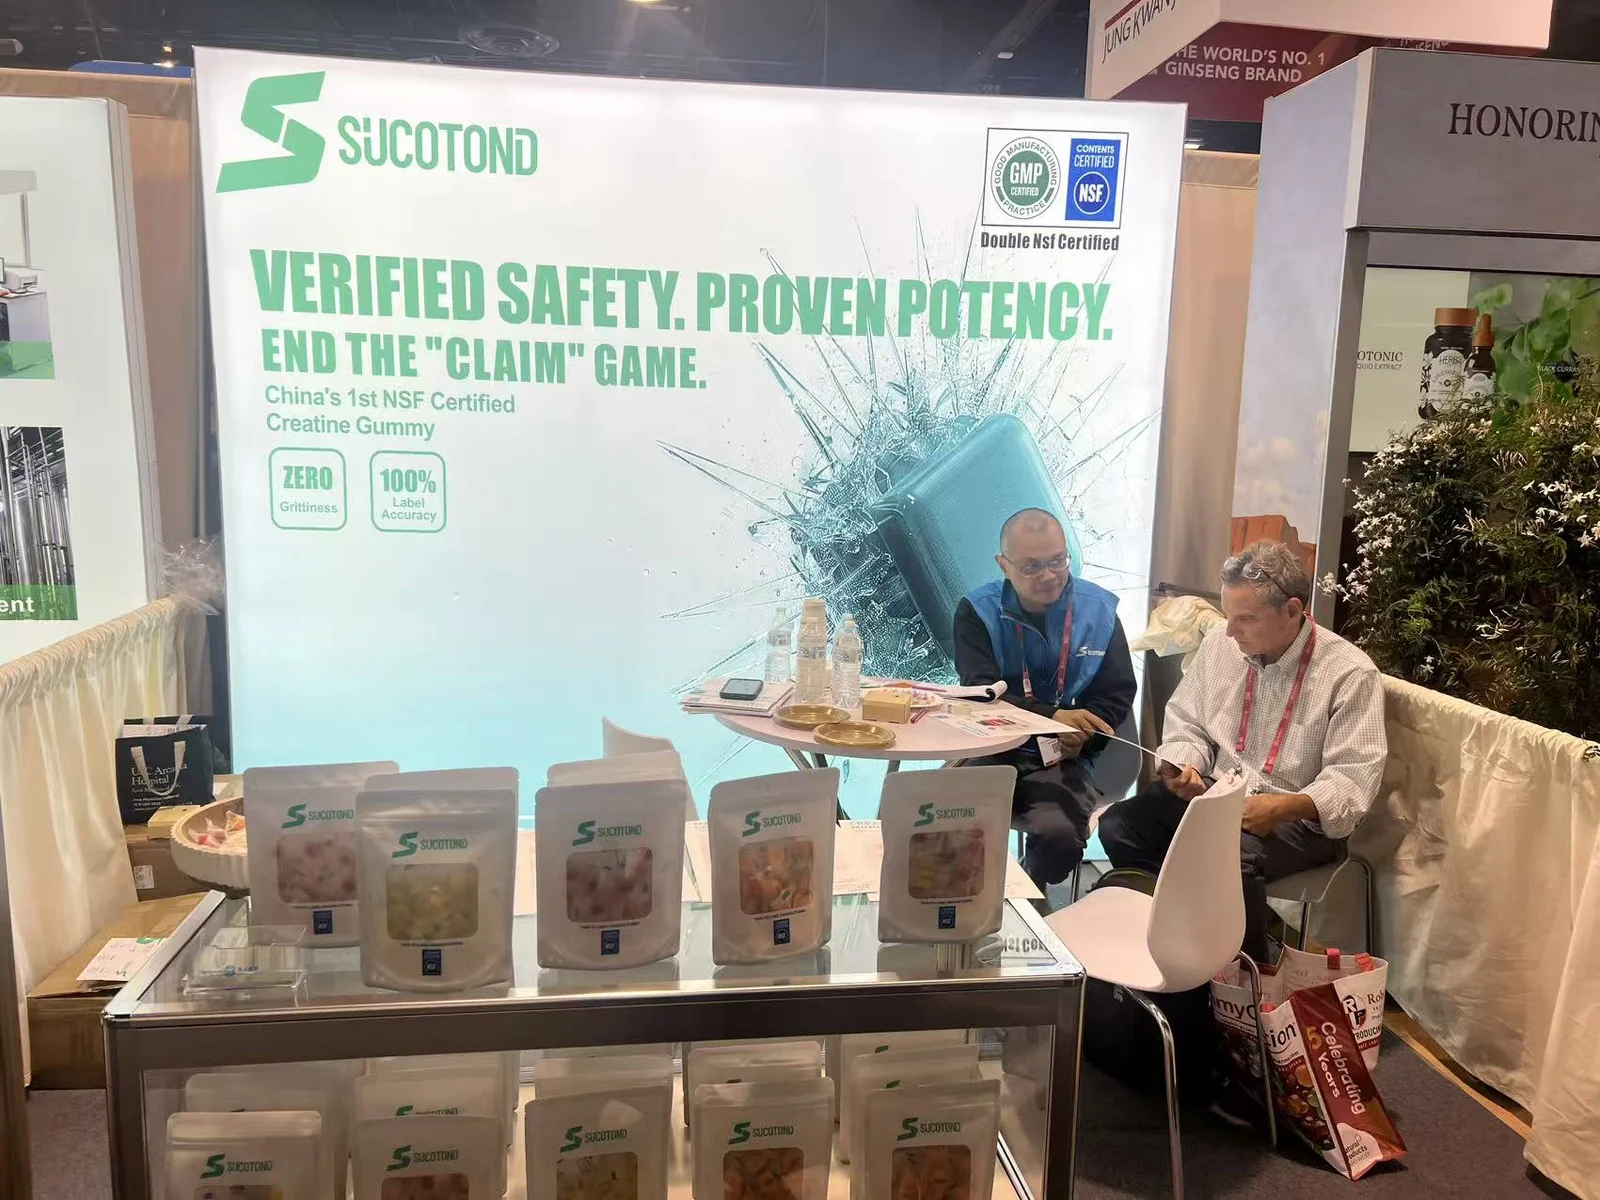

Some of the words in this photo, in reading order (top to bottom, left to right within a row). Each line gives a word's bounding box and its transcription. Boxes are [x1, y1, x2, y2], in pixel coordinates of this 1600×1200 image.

[1102, 17, 1131, 64] JUNG
[1175, 45, 1198, 59] HE
[1203, 46, 1277, 63] WORLD'S
[1281, 51, 1312, 66] NO.
[1317, 52, 1325, 66] 1
[1165, 61, 1240, 80] GINSENG
[1245, 67, 1302, 83] BRAND
[337, 114, 539, 176] SUCOTOND
[1076, 145, 1115, 154] CONTENTS
[994, 156, 1007, 184] GOOD
[1006, 141, 1058, 186] MANUFACTURING
[1074, 155, 1115, 168] CERTIFIED
[1009, 162, 1043, 185] GMP
[1010, 186, 1040, 197] CERTIFIED
[1079, 183, 1104, 203] NSF
[1002, 200, 1046, 216] PRACTICE
[980, 232, 1030, 249] Double
[1033, 232, 1055, 249] Nsf
[1058, 233, 1120, 251] Certified
[249, 249, 485, 321] VERIFIED
[497, 261, 686, 331] SAFETY.
[697, 272, 887, 337] PROVEN
[900, 278, 1113, 341] POTENCY.
[261, 328, 337, 374] END
[345, 331, 418, 378] THE
[425, 335, 585, 384] "CLAIM"
[594, 343, 707, 389] GAME.
[265, 385, 342, 406] China's
[347, 388, 378, 408] 1st
[383, 390, 425, 409] NSF
[431, 391, 516, 413] Certified
[266, 413, 351, 434] Creatine
[356, 415, 435, 441] Gummy
[283, 465, 333, 490] ZERO
[380, 468, 437, 494] 100%
[280, 501, 338, 514] Grittiness
[392, 497, 425, 508] Label
[381, 509, 437, 523] Accuracy
[132, 775, 169, 787] Hopital
[762, 812, 802, 828] SUCOTOND
[936, 807, 976, 820] SUCOTOND
[598, 824, 642, 837] SUCOTOND
[420, 839, 468, 850] SUCOTOND
[1316, 1051, 1341, 1098] Years
[1320, 1021, 1366, 1115] Celebrating
[584, 1128, 628, 1143] SUCOTOND
[752, 1126, 794, 1138] SUCOTOND
[413, 1149, 459, 1163] SUCOTOND
[226, 1160, 273, 1172] SUCOTOND
